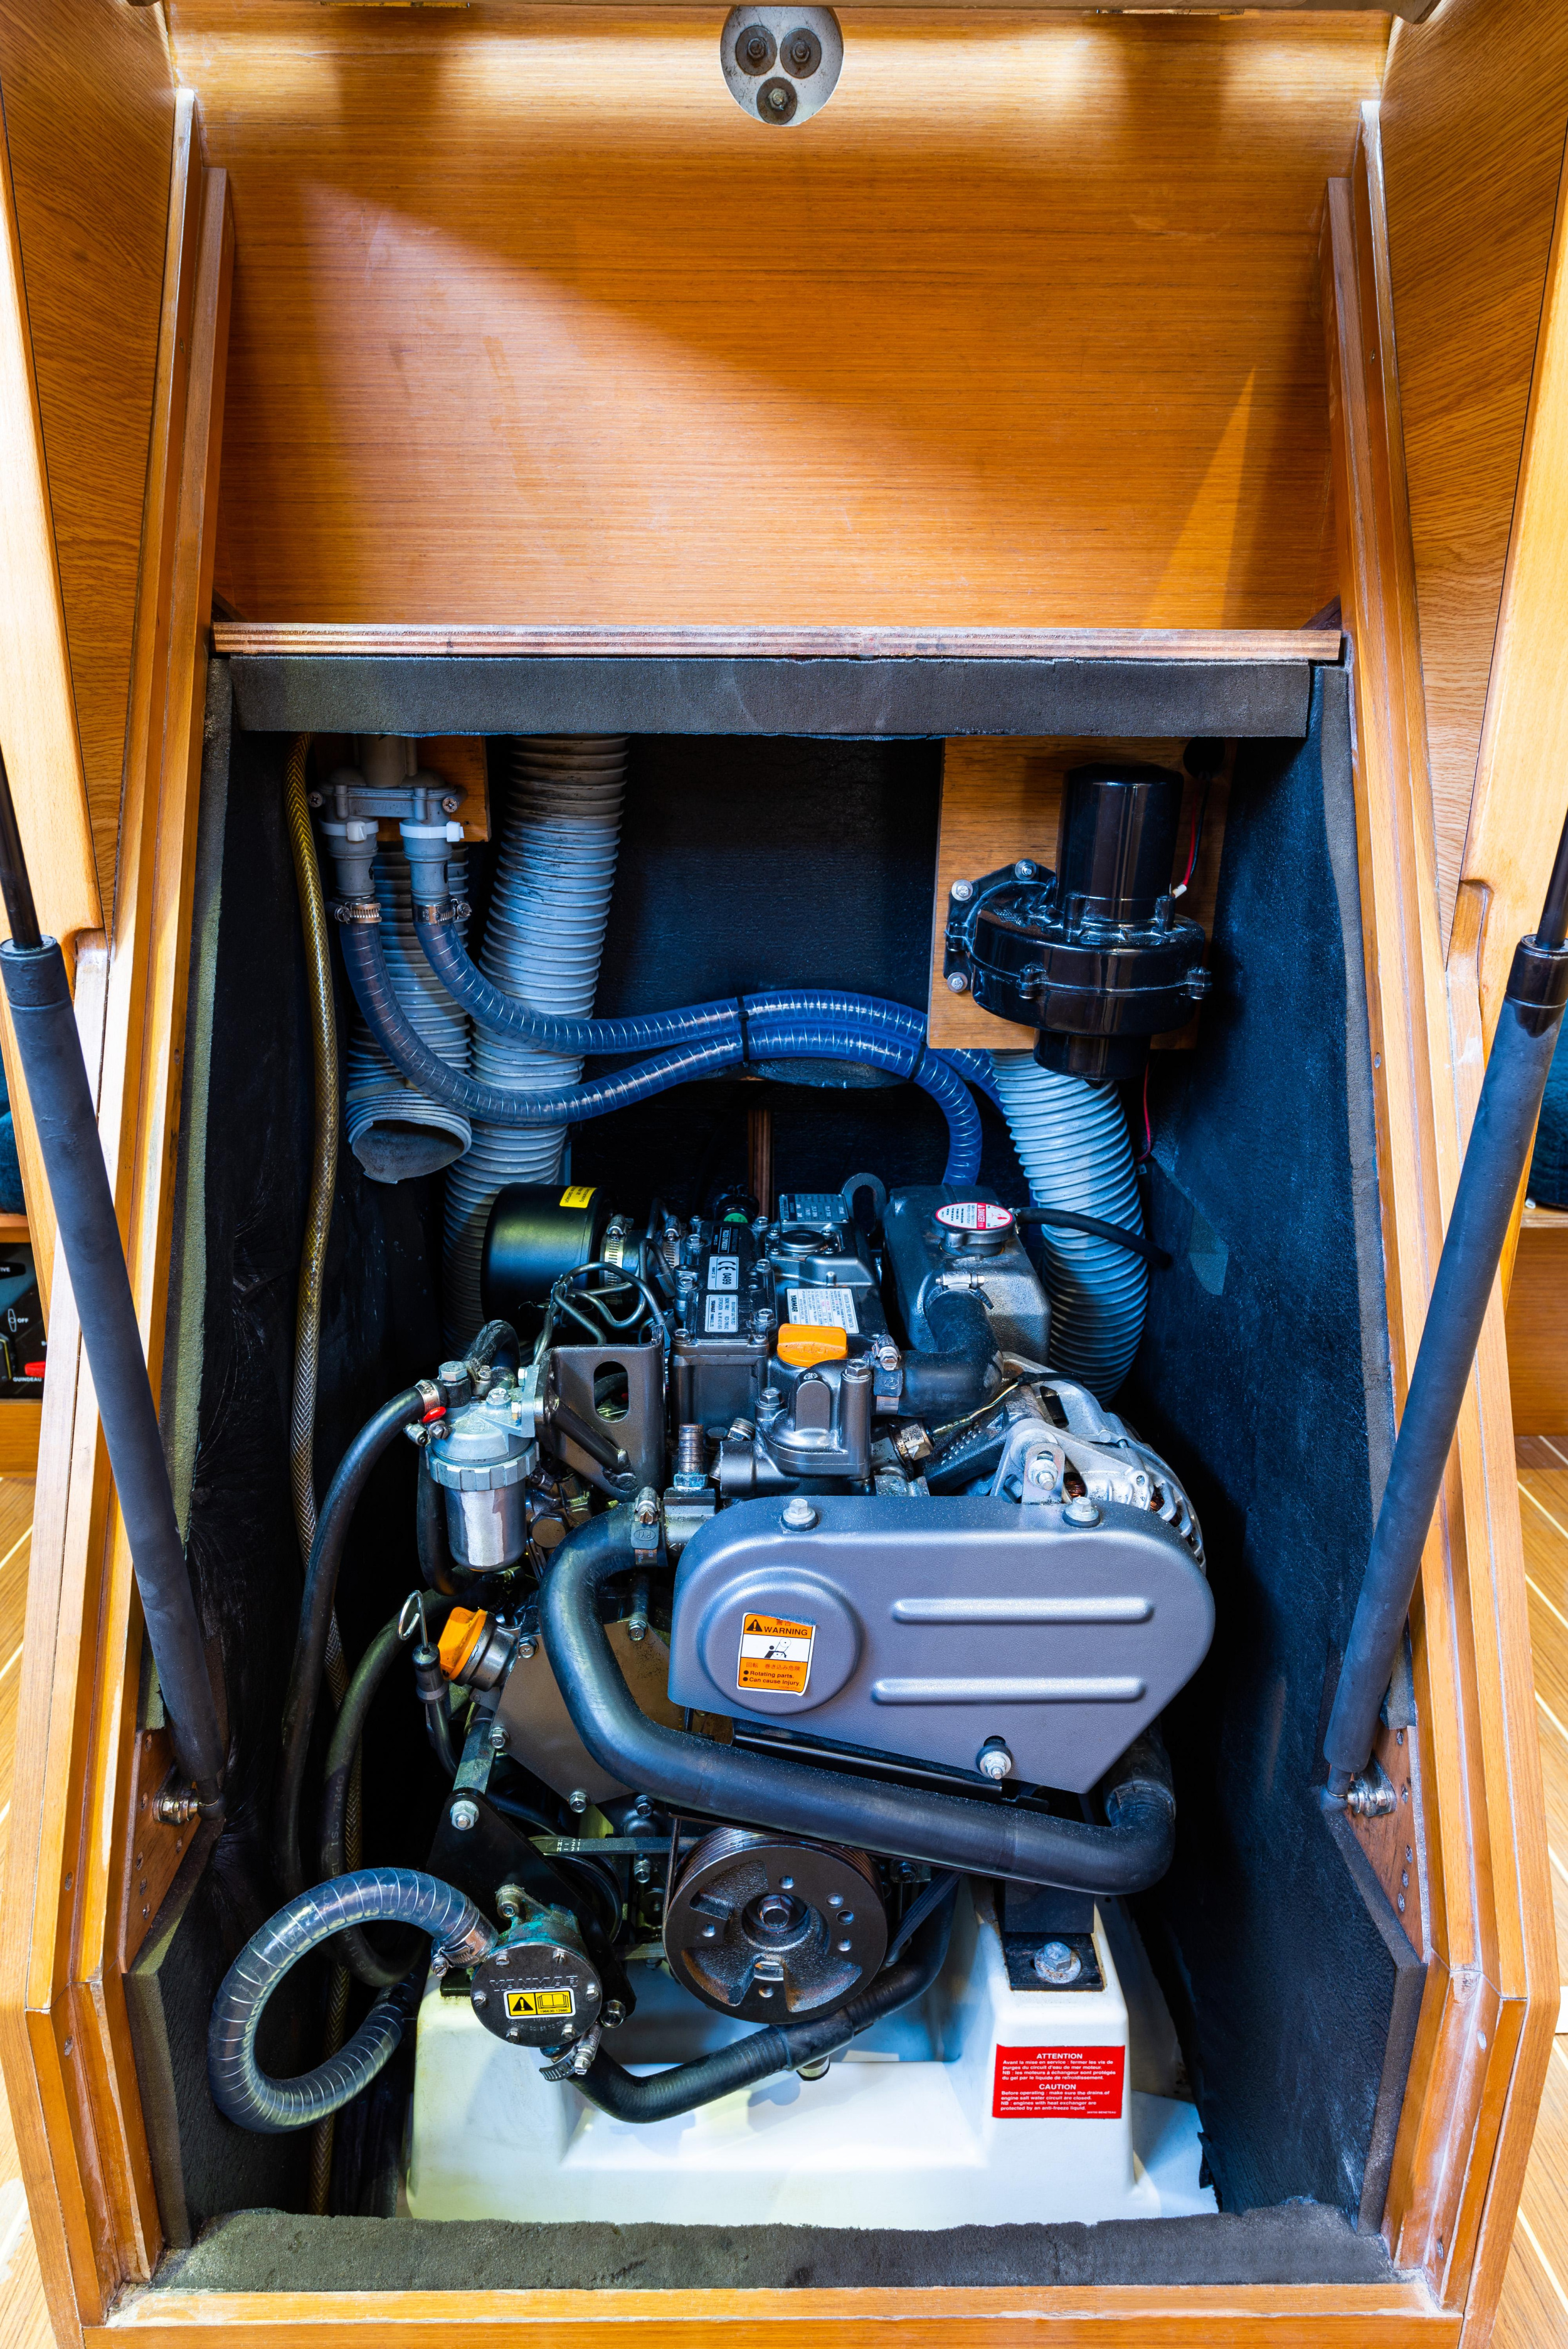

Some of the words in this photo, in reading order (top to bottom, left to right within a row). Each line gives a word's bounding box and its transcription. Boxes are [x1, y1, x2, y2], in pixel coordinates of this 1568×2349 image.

[977, 1208, 985, 1222] DANGER
[722, 1273, 732, 1285] 0499
[764, 1626, 808, 1636] WARNING
[750, 1670, 776, 1678] Rotating
[332, 1775, 344, 1813] 7840
[331, 1821, 339, 1847] ISO
[489, 1975, 579, 1991] YANMAR
